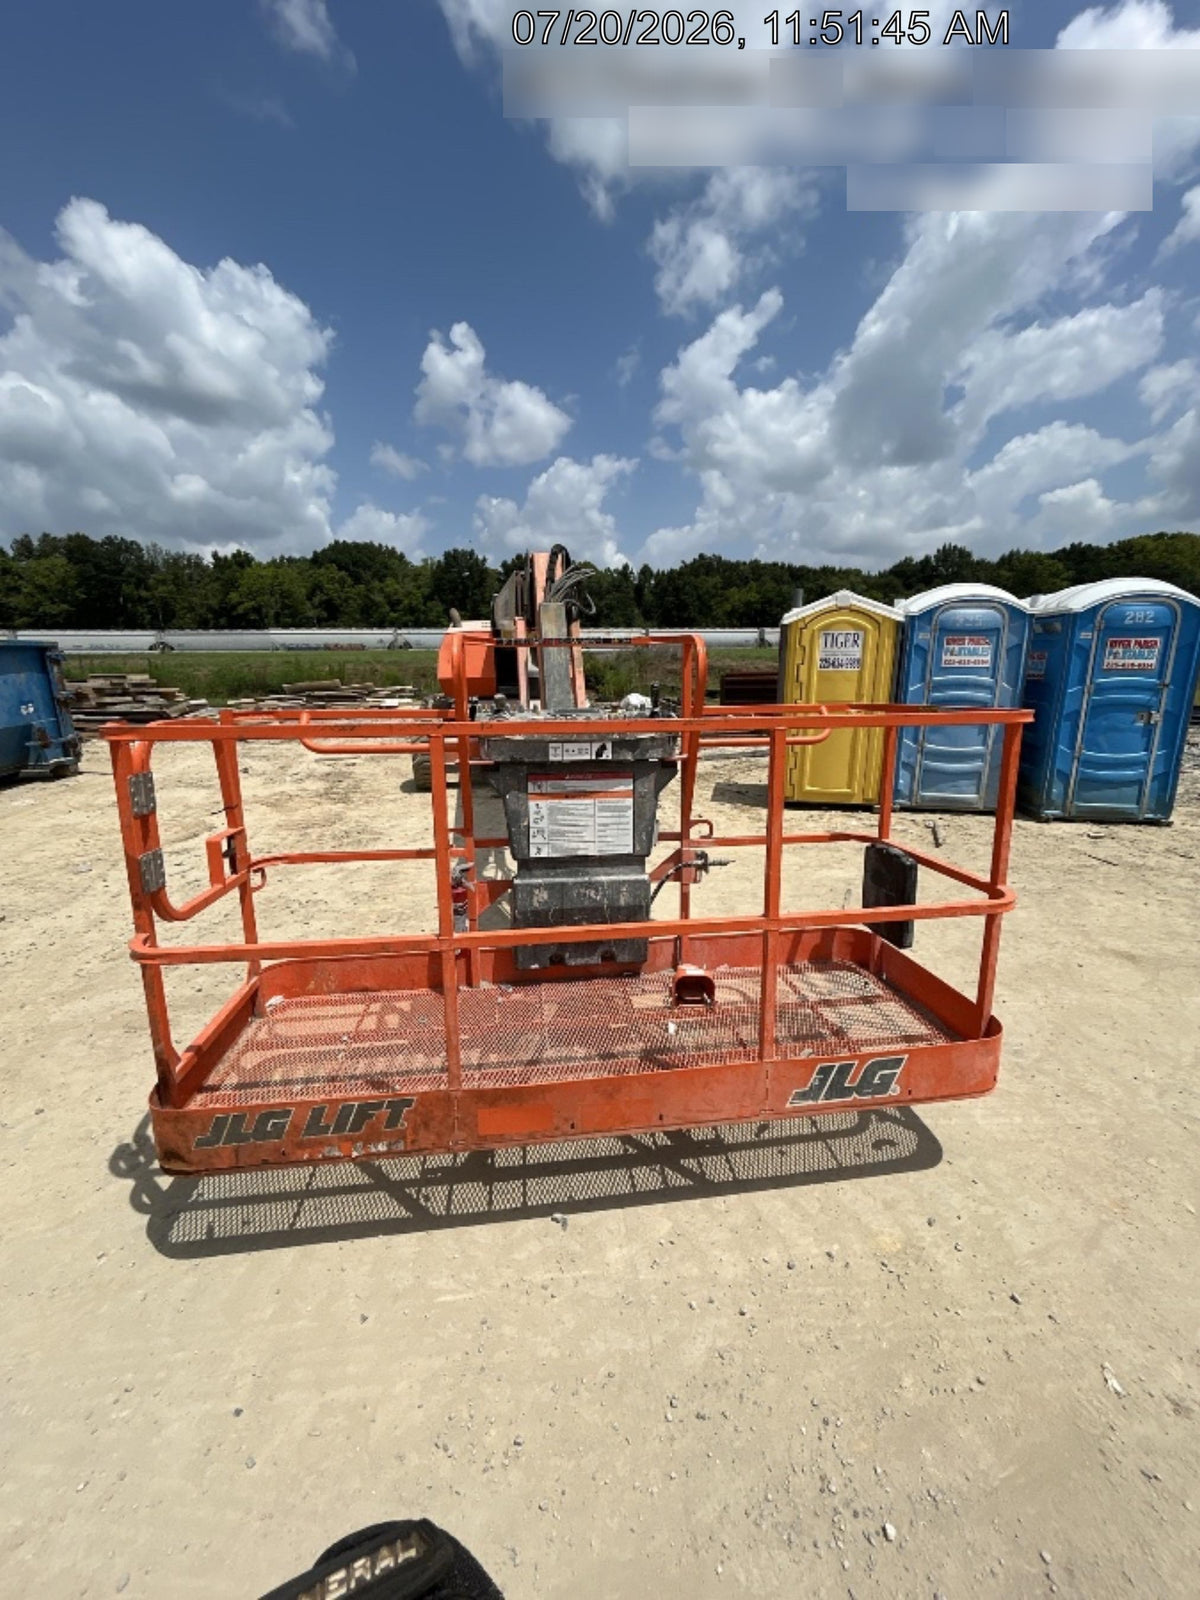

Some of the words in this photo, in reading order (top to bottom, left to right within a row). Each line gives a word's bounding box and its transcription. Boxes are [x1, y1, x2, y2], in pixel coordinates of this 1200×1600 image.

[822, 631, 860, 649] TIGER
[786, 1054, 909, 1108] JLG
[192, 1107, 296, 1150] JLG
[301, 1096, 417, 1138] LIFT
